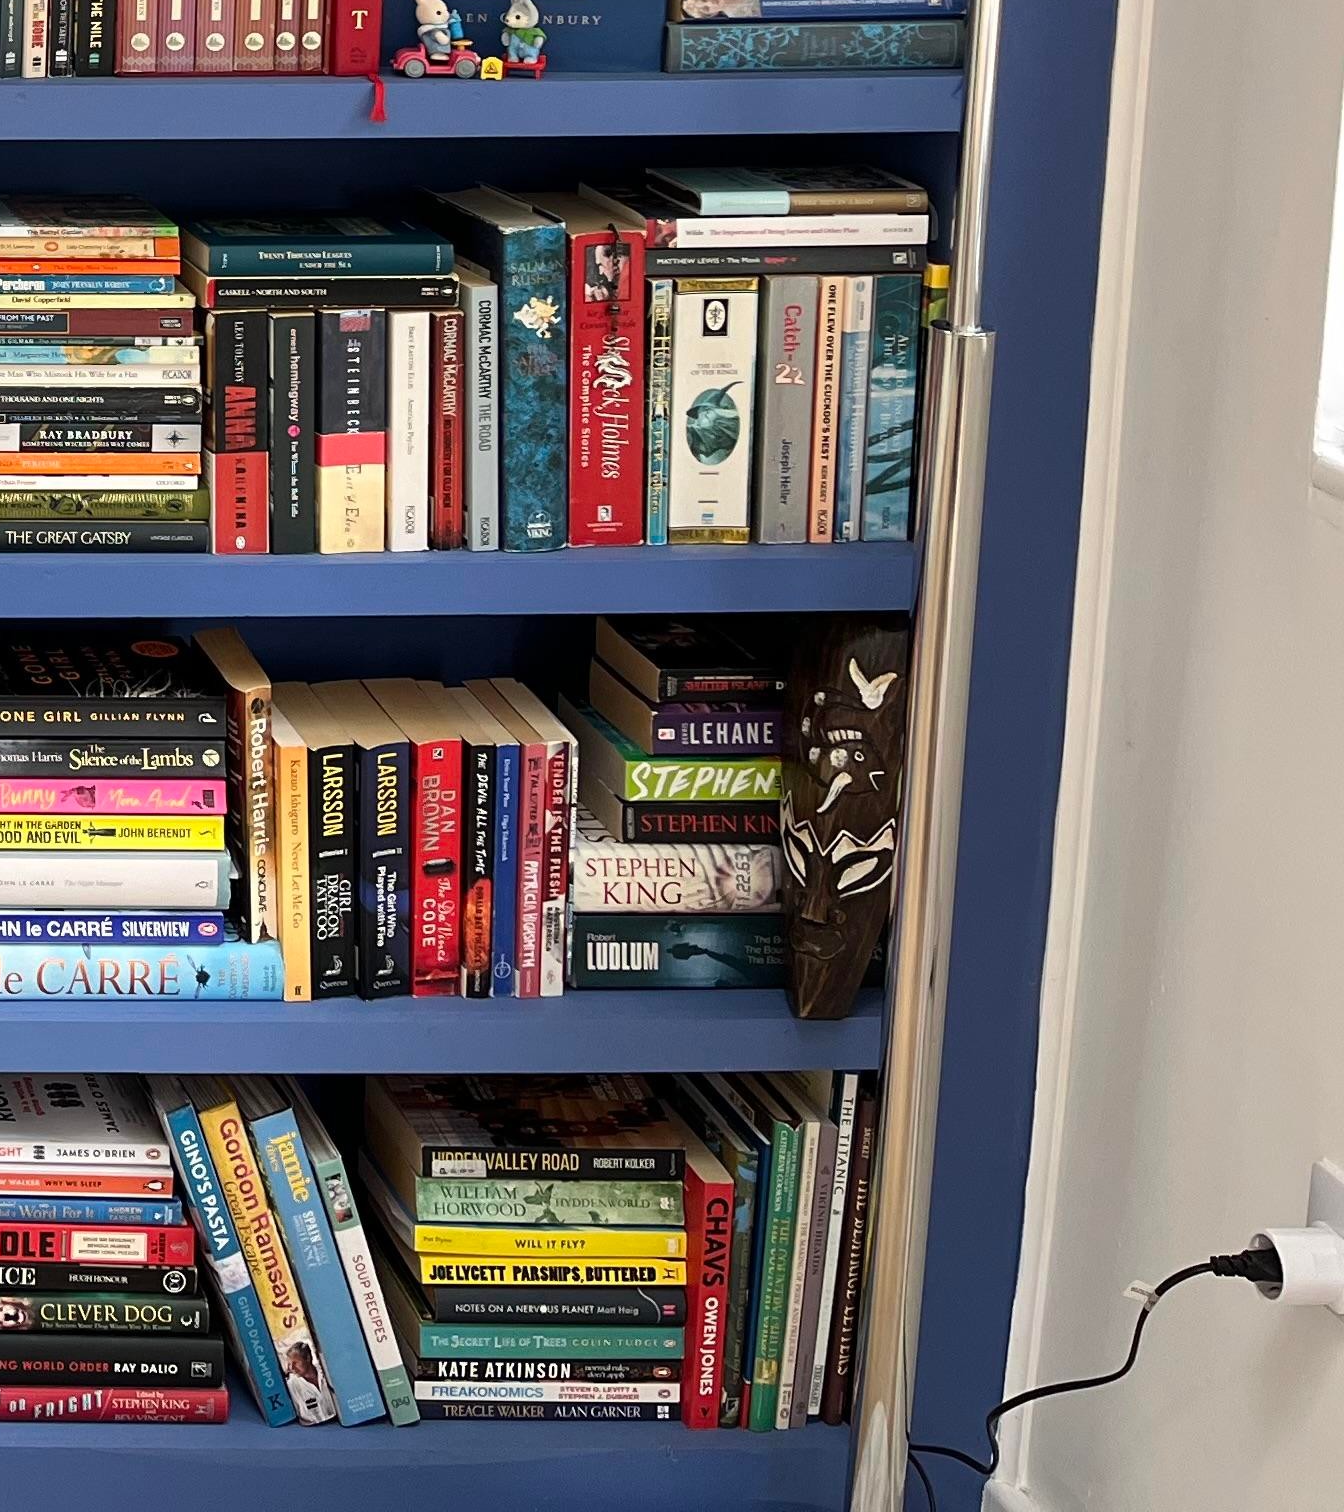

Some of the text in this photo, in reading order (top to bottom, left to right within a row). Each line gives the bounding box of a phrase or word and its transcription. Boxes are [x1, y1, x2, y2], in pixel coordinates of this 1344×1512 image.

[775, 363, 806, 385] 22
[39, 430, 133, 441] RAY BRADBURY
[779, 438, 793, 506] Joseph Heller
[5, 530, 131, 546] THE GREAT GATSBY
[43, 710, 81, 722] GIRL
[90, 712, 140, 722] GILLIAN
[146, 712, 185, 721] FLYNN
[690, 723, 774, 744] LEHANE
[322, 753, 343, 836] LARSSON
[586, 857, 696, 879] STEPHEN
[603, 882, 683, 905] KING
[26, 920, 42, 936] le
[46, 917, 113, 937] CARRÉ
[122, 921, 190, 938] SILVERVIEW
[587, 942, 660, 971] LUDLUM
[703, 1197, 728, 1288] CHAVS
[40, 1303, 172, 1323] CLEVER DOG
[698, 1297, 720, 1397] OWEN JONES
